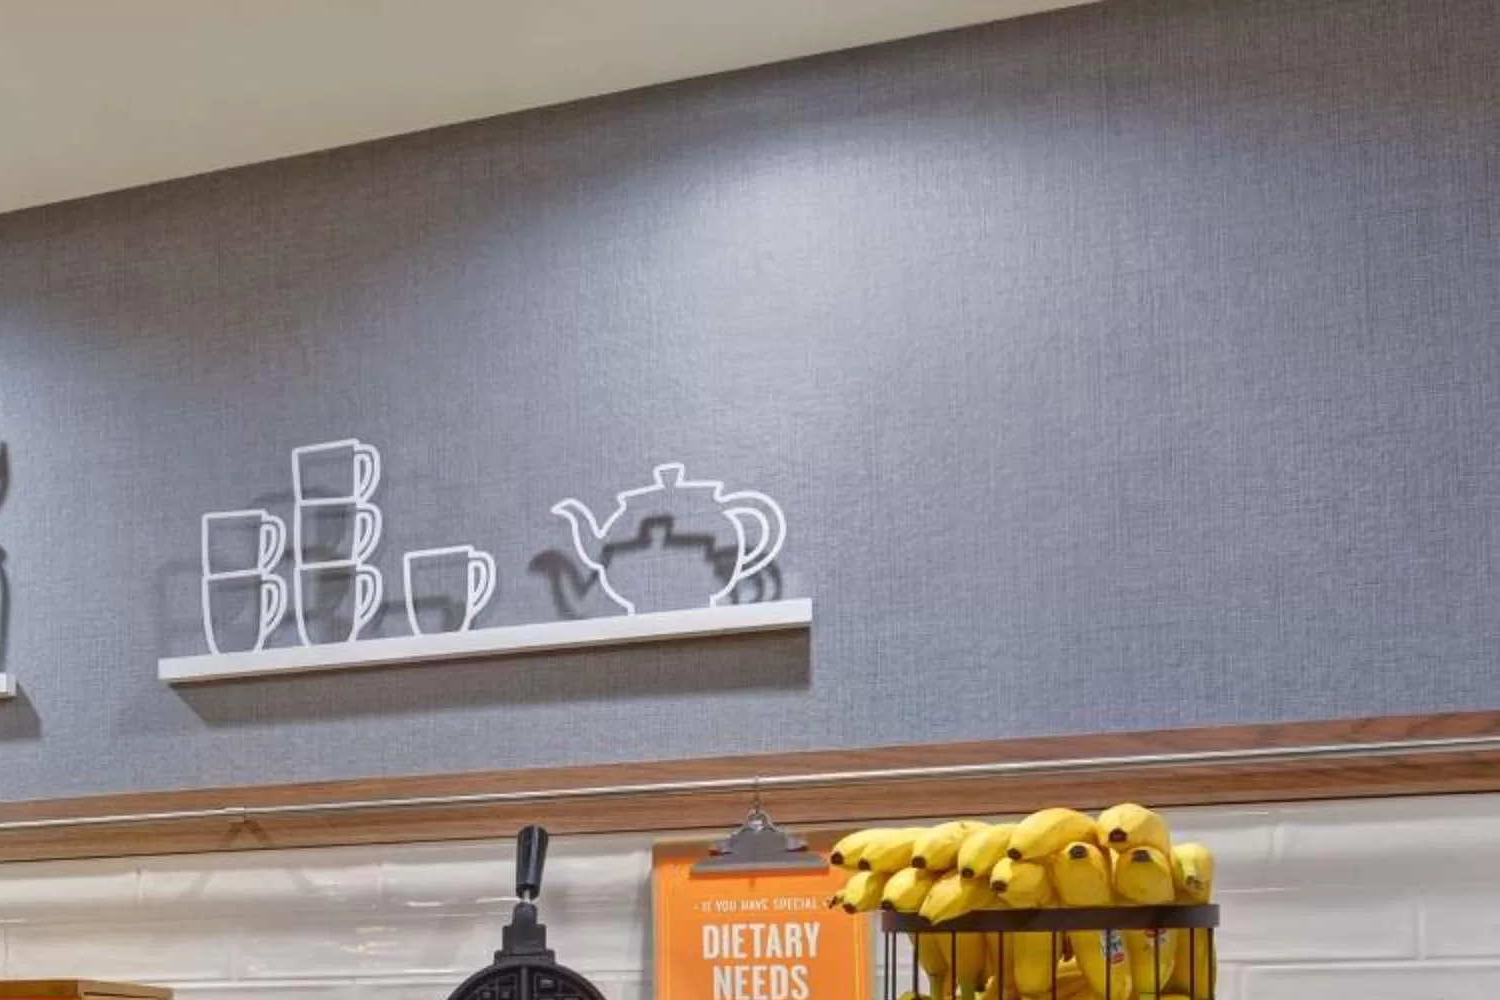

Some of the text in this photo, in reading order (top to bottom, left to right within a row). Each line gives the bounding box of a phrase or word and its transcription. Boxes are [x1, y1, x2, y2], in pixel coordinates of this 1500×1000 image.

[715, 900, 736, 913] YOU
[740, 899, 769, 911] HAVE
[773, 897, 817, 911] SPECIAL
[703, 922, 821, 960] DIETARY
